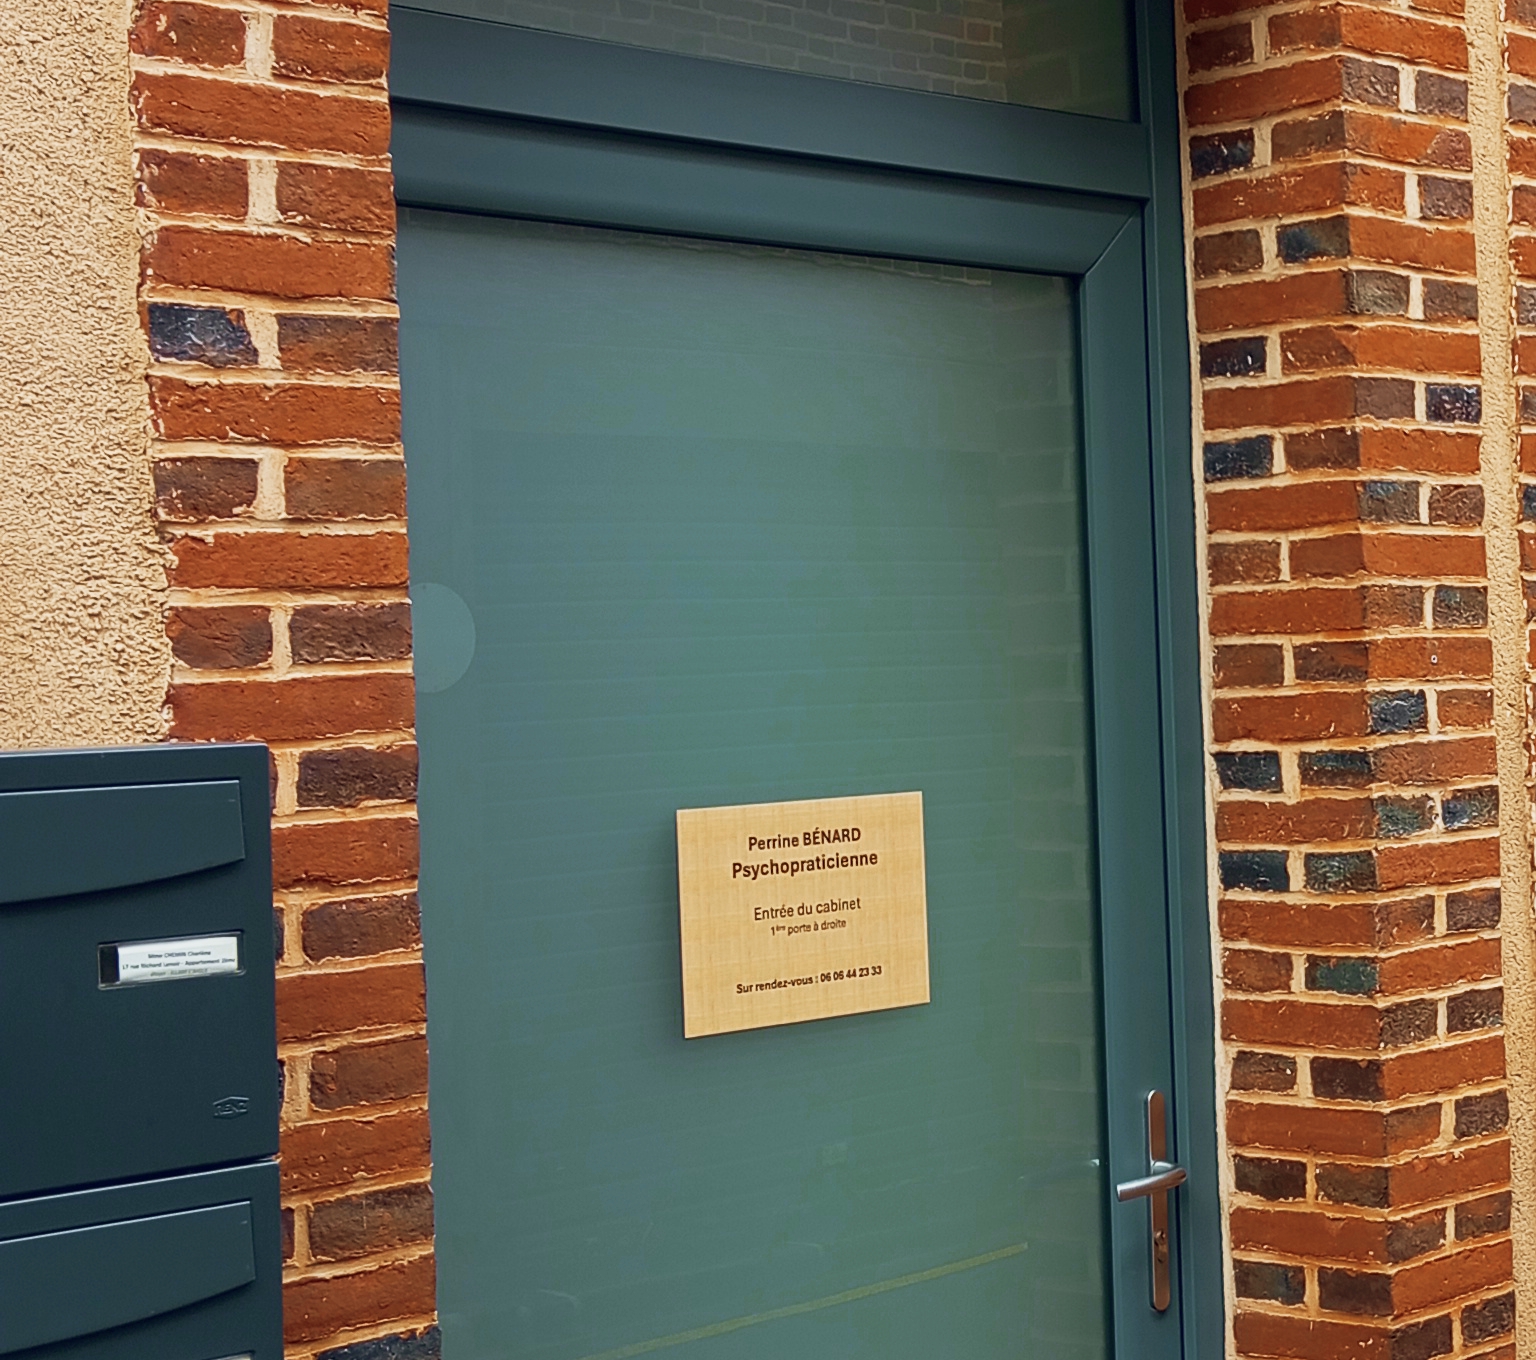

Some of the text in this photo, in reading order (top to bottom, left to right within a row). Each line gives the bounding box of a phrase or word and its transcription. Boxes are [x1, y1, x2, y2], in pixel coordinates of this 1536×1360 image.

[748, 827, 862, 851] Perrine BÉNARD
[732, 851, 879, 880] Psychopraticienne
[753, 897, 862, 921] Entrée du cabinet
[787, 923, 812, 936] porte
[813, 920, 820, 931] à
[820, 918, 847, 931] droite
[736, 983, 754, 995] Sur
[755, 976, 813, 991] rendez-vous
[820, 972, 831, 983] 06
[846, 968, 857, 979] 44
[859, 967, 870, 978] 23
[871, 965, 882, 976] 33
